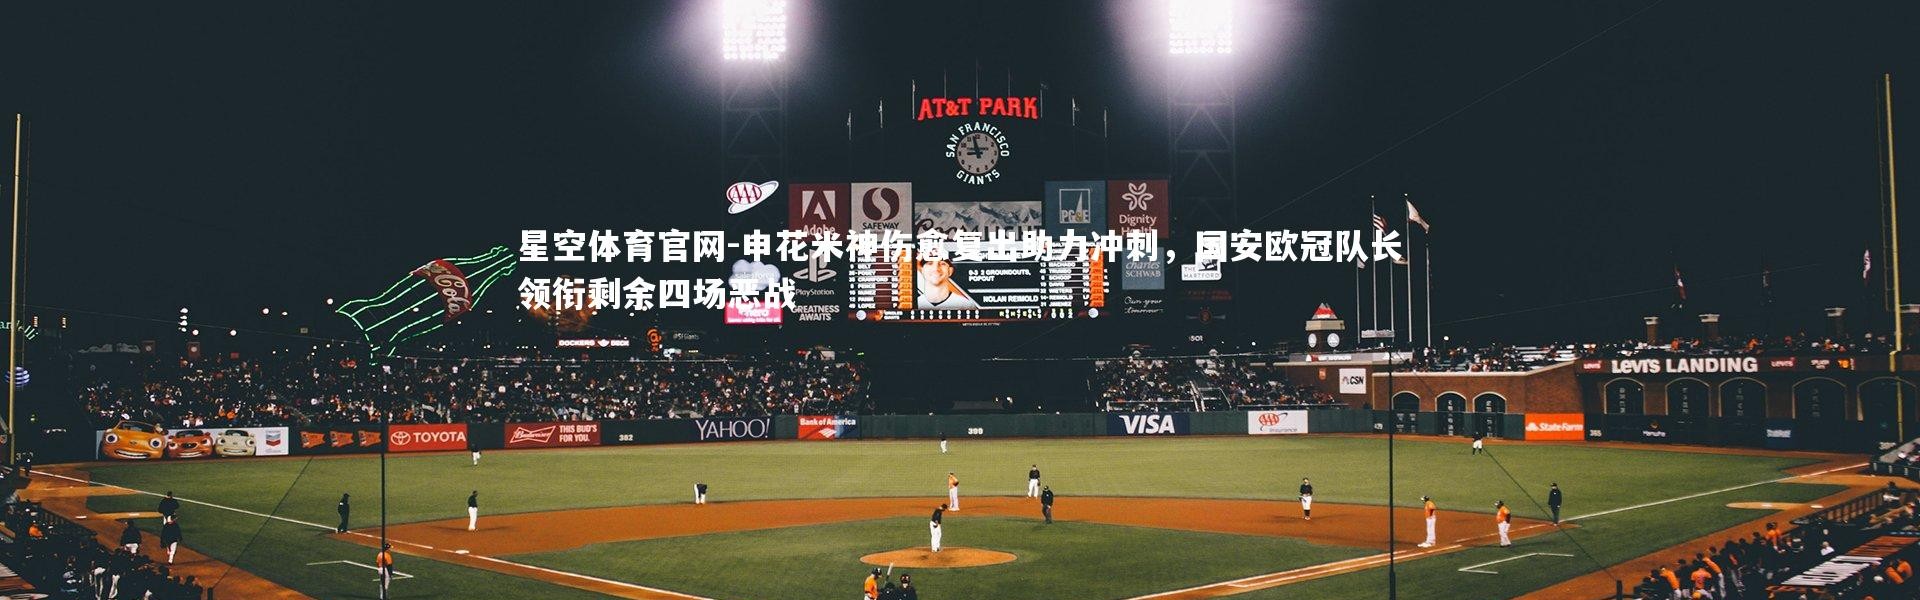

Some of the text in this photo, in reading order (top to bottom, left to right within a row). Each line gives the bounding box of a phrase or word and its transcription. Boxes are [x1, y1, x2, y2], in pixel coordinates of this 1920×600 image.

[917, 96, 1039, 121] AT&T PARK
[945, 121, 1010, 158] SAN FRANCISCO
[956, 168, 1000, 185] GIANTS
[1119, 214, 1157, 227] Dignity
[803, 224, 836, 236] Adobe
[862, 222, 900, 230] SAFEWAY
[1125, 270, 1161, 278] SCHWAB
[795, 289, 835, 297] PlayStation
[983, 295, 1007, 303] NOLAN
[792, 305, 840, 313] GREATNESS
[799, 313, 832, 321] AWAITS
[1665, 357, 1758, 373] LANDING
[1349, 376, 1364, 385] CSN
[800, 418, 856, 426] Bank of America
[1119, 414, 1176, 434] VISA
[560, 425, 598, 433] THIS BUD'S
[696, 418, 770, 440] YAHOO!
[413, 431, 467, 443] TOYOTA
[514, 431, 552, 439] Budweiser
[560, 434, 590, 442] FOR YOU.
